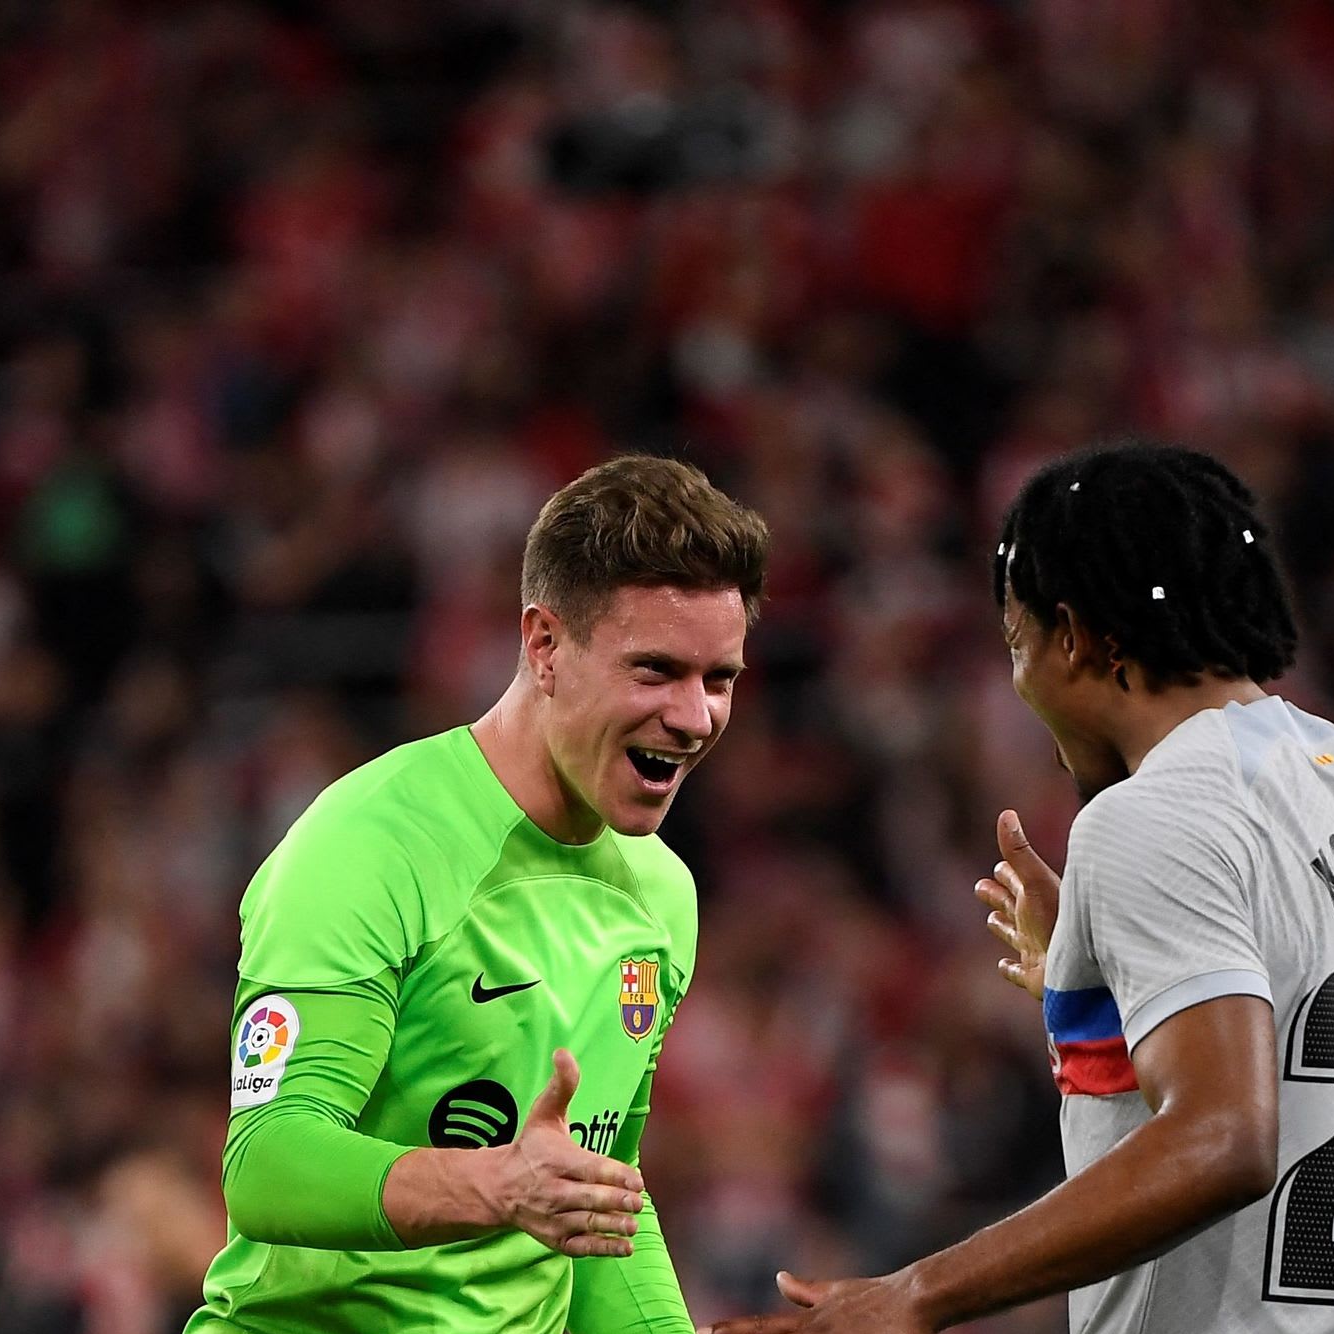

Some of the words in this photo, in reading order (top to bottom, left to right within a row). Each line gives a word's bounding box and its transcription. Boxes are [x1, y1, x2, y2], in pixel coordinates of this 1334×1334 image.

[629, 993, 645, 1004] FCB
[233, 1072, 275, 1093] LaLiga
[569, 1109, 620, 1156] otif
